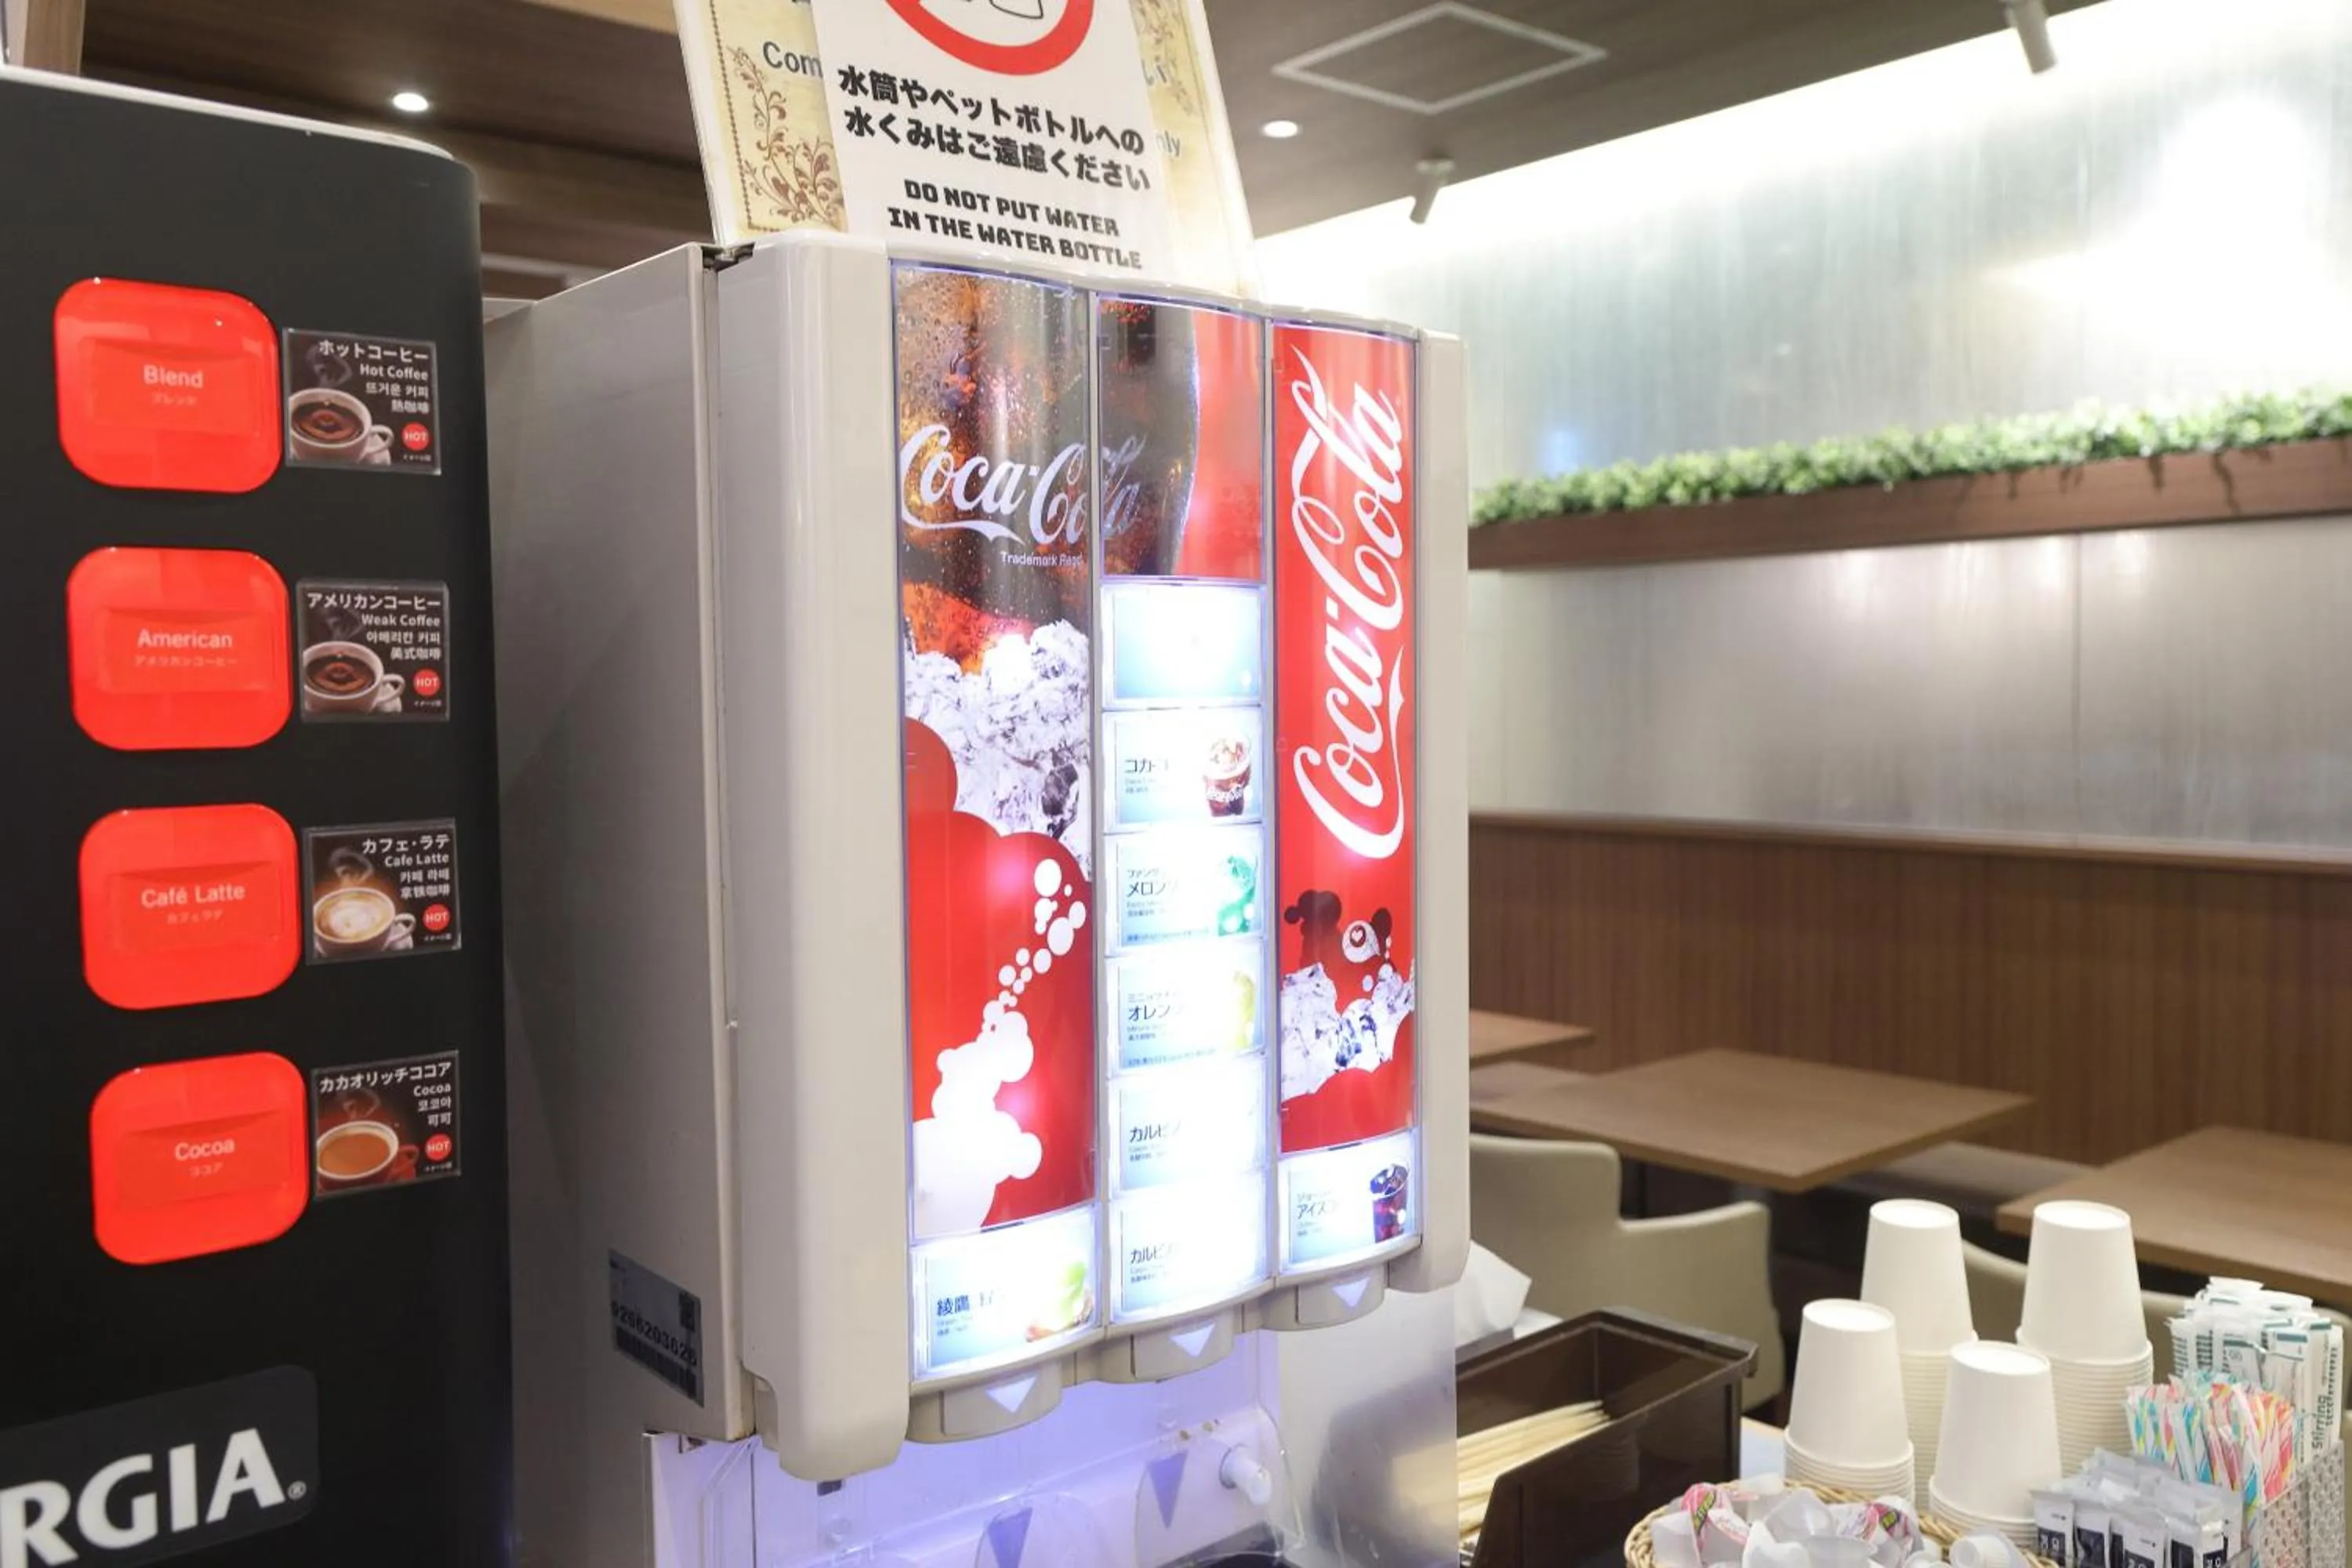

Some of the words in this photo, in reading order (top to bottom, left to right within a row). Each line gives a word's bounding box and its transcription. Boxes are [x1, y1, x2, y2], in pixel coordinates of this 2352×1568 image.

[837, 65, 1145, 156] 水筒やペットボトルへの
[844, 105, 1152, 192] 水くみはご遠慮ください
[904, 178, 939, 204] DO
[943, 186, 991, 214] NOT
[996, 197, 1040, 223] PUT
[1045, 205, 1120, 238] WATER
[887, 206, 921, 231] IN
[925, 212, 973, 241] THE
[977, 223, 1056, 255] WATER
[1059, 238, 1143, 270] BOTTLE
[319, 339, 429, 363] ホットコーヒー
[143, 364, 204, 389] Blend
[359, 364, 384, 377] Hot
[387, 366, 429, 380] Coffee
[404, 430, 428, 441] HOT
[1000, 551, 1058, 568] Trademark
[307, 592, 441, 611] アメリカンコーヒー
[1290, 343, 1405, 860] Coca-Cola
[361, 614, 397, 626] Weak
[400, 614, 441, 626] Coffee
[137, 628, 233, 649] American
[416, 677, 440, 688] HOT
[416, 853, 449, 866] Latte
[141, 886, 188, 909] Café
[194, 883, 246, 903] Latte
[424, 911, 448, 924] HOT
[320, 1062, 452, 1094] カカオリッチココア
[413, 1083, 452, 1097] Cocoa
[427, 1112, 452, 1127] 可可
[175, 1138, 235, 1162] Cocoa
[426, 1141, 450, 1152] HOT
